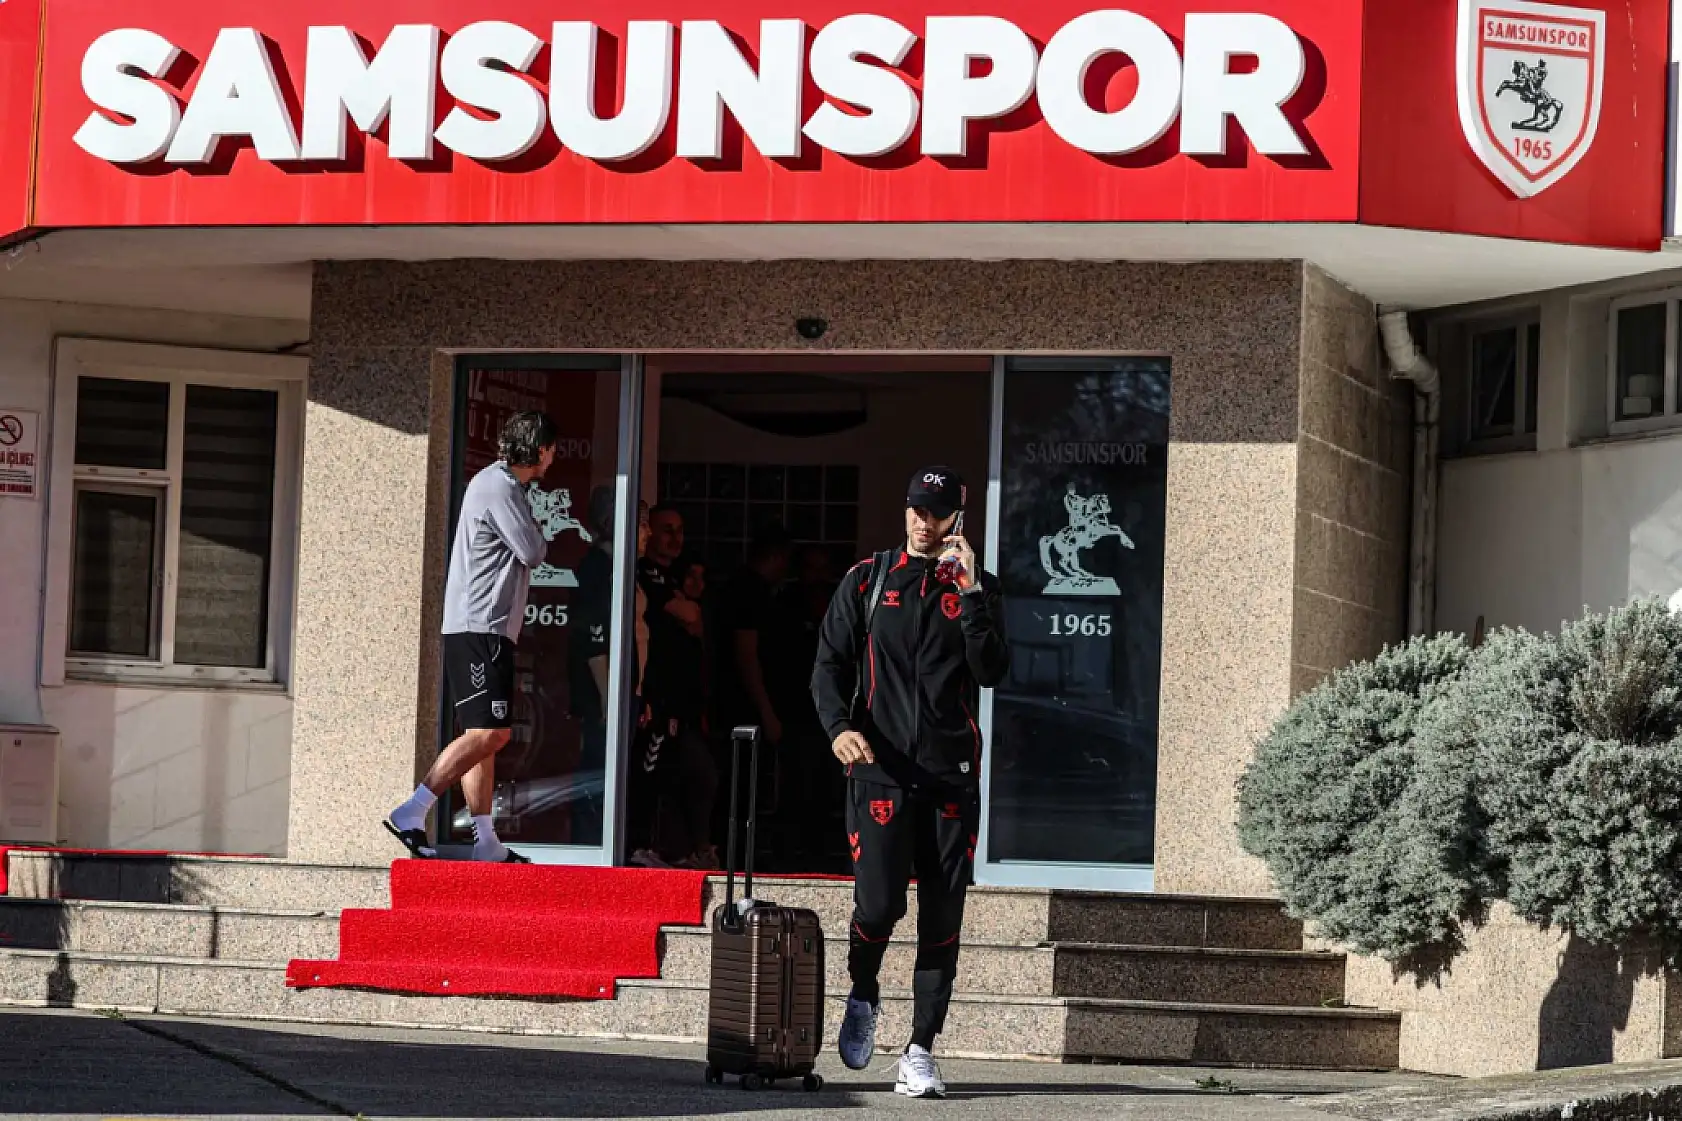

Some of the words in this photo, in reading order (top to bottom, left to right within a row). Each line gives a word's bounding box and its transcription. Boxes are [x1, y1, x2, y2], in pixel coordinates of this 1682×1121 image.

[1486, 20, 1588, 48] SAMSUNSPOR
[73, 10, 1311, 162] SAMSUNSPOR
[1513, 136, 1552, 161] 1965
[1025, 441, 1148, 465] SAMSUNSPOR
[923, 473, 946, 488] OK
[524, 603, 568, 626] 965
[1049, 613, 1112, 637] 1965
